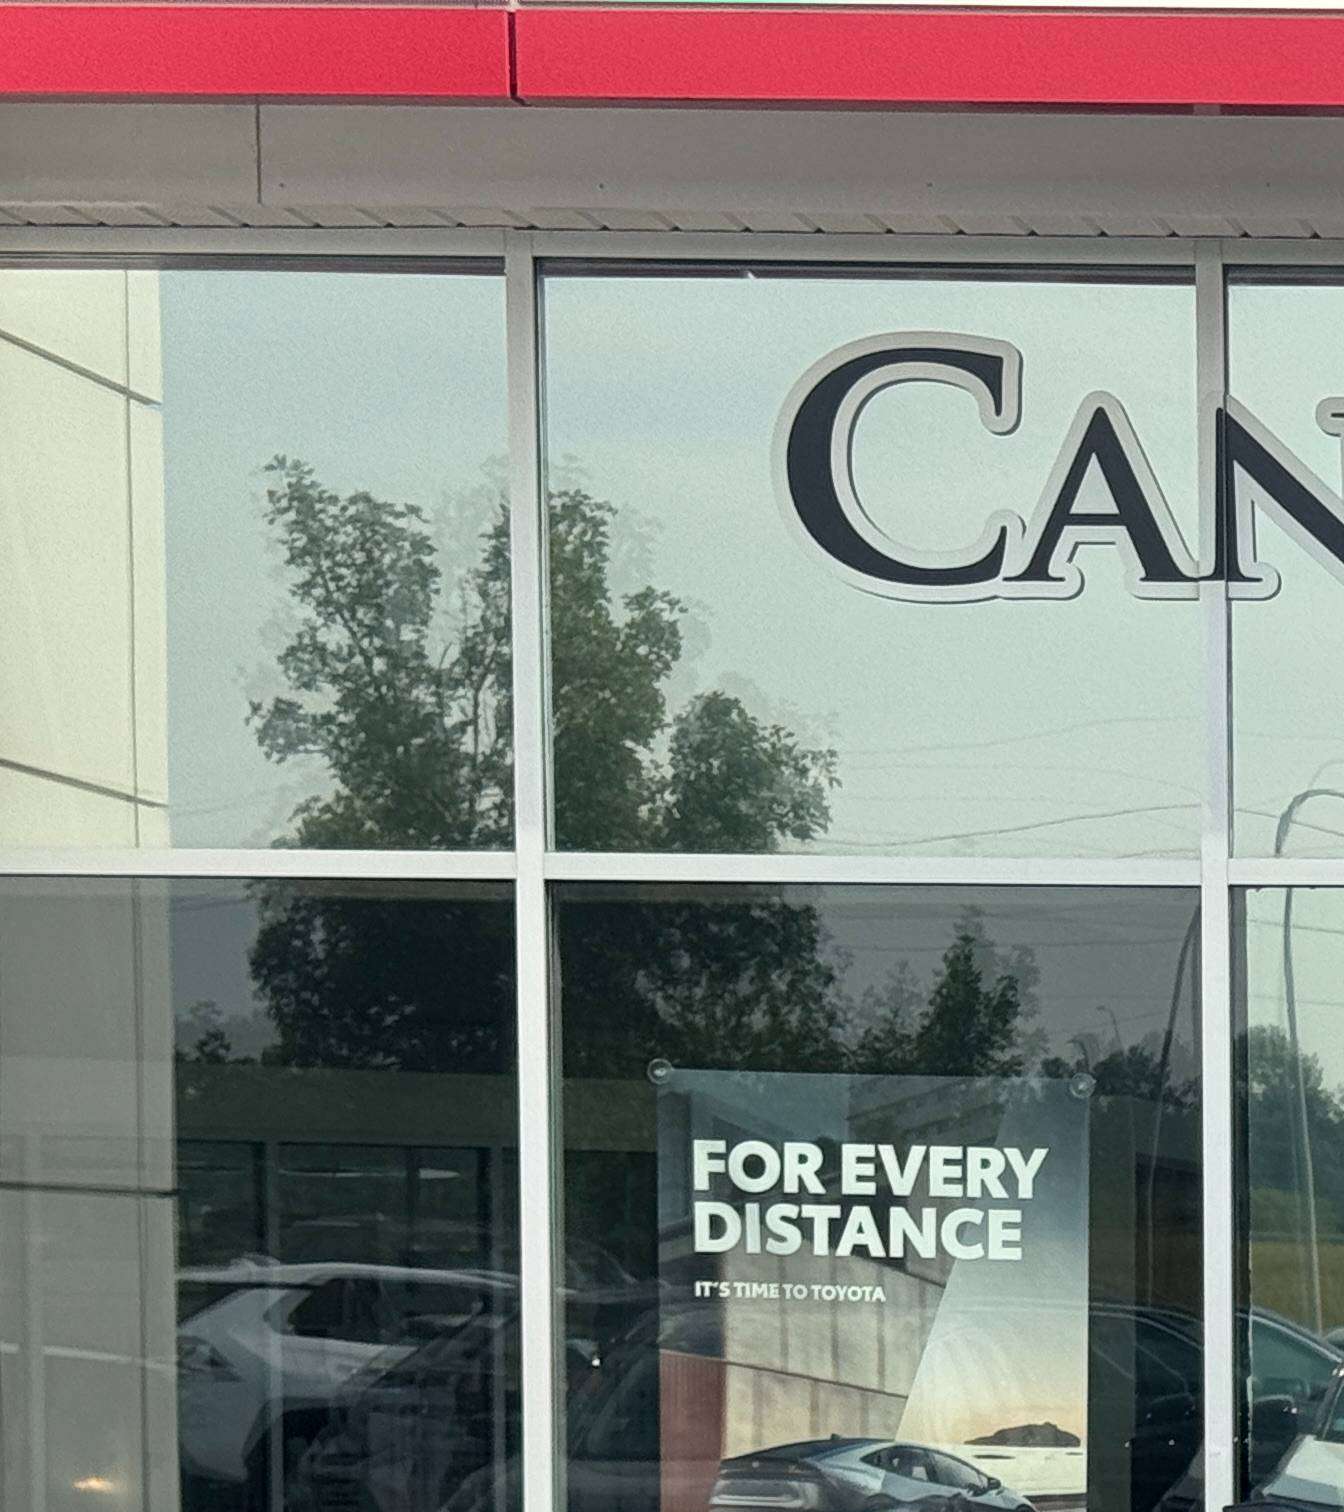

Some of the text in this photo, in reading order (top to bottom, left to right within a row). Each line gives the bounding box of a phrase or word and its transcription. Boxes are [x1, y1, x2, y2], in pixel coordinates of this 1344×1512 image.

[693, 1139, 1050, 1199] FOR EVERY
[694, 1201, 1023, 1261] DISTANCE
[694, 1281, 887, 1302] IT'S TIME TO TOYOTA
